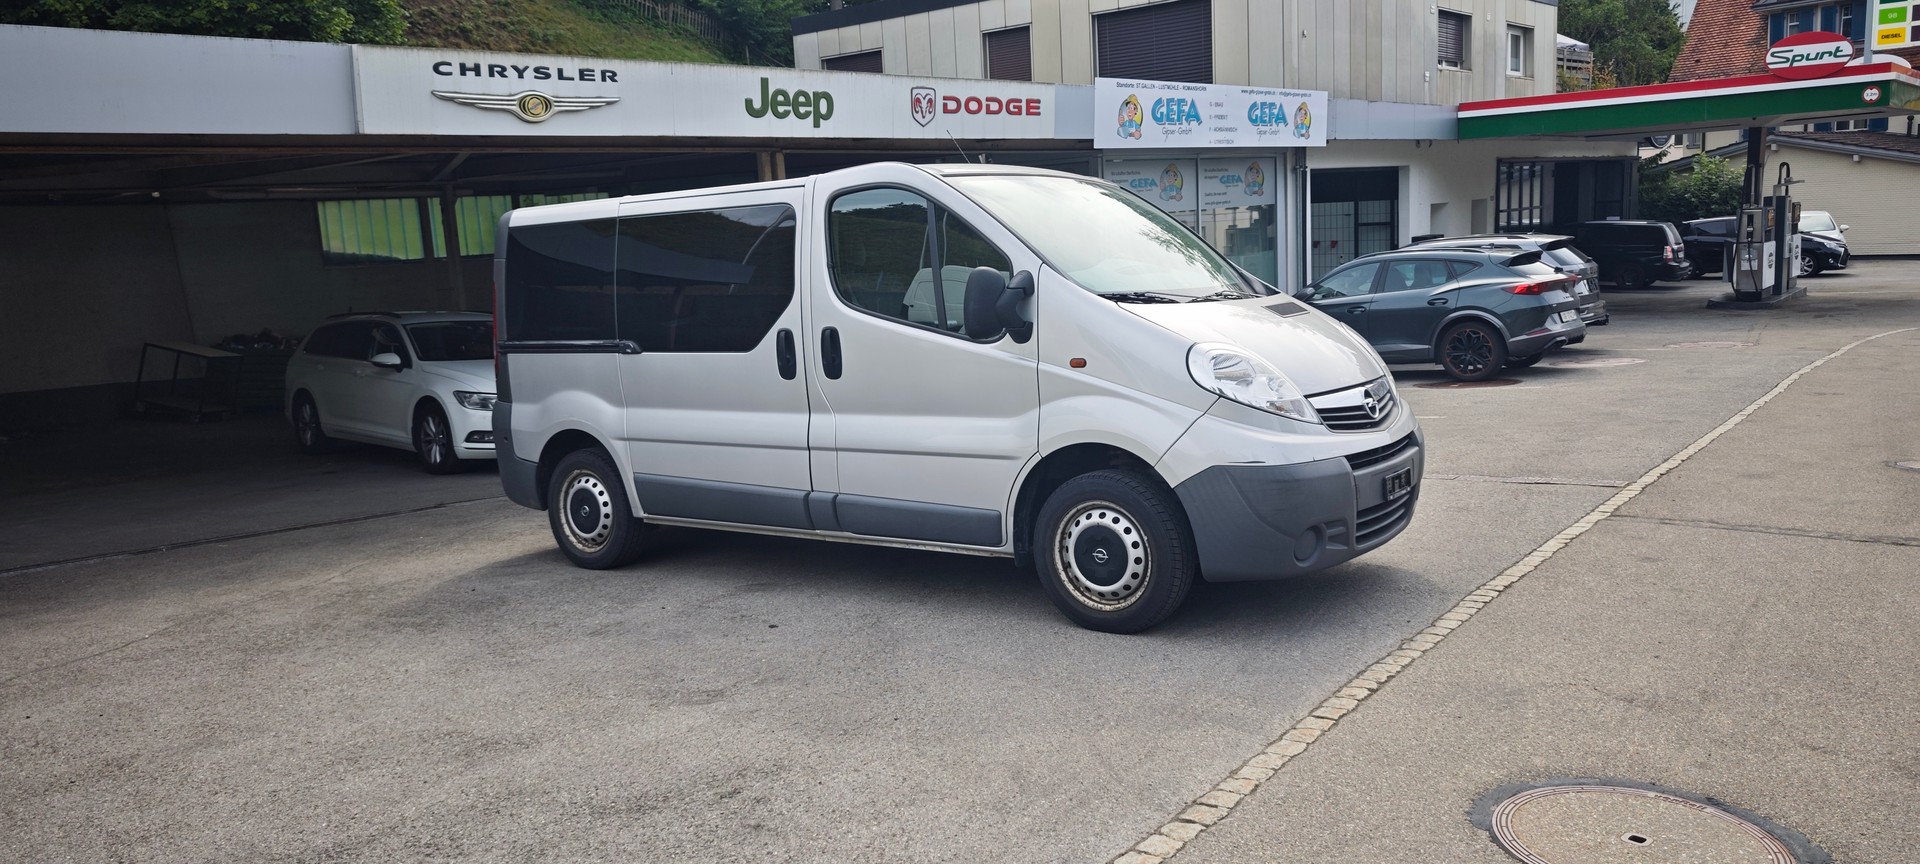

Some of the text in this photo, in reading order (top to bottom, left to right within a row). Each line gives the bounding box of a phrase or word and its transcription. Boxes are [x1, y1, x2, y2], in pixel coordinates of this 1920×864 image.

[1881, 32, 1902, 40] DIESEL
[1767, 46, 1852, 67] Spurt
[432, 61, 619, 83] CHRYSLER
[744, 77, 834, 128] Jeep
[942, 95, 1041, 116] DODGE
[1151, 97, 1203, 126] GEFA
[1248, 101, 1288, 127] GEFA
[1130, 178, 1158, 188] GEFA
[1219, 174, 1243, 184] GEFA
